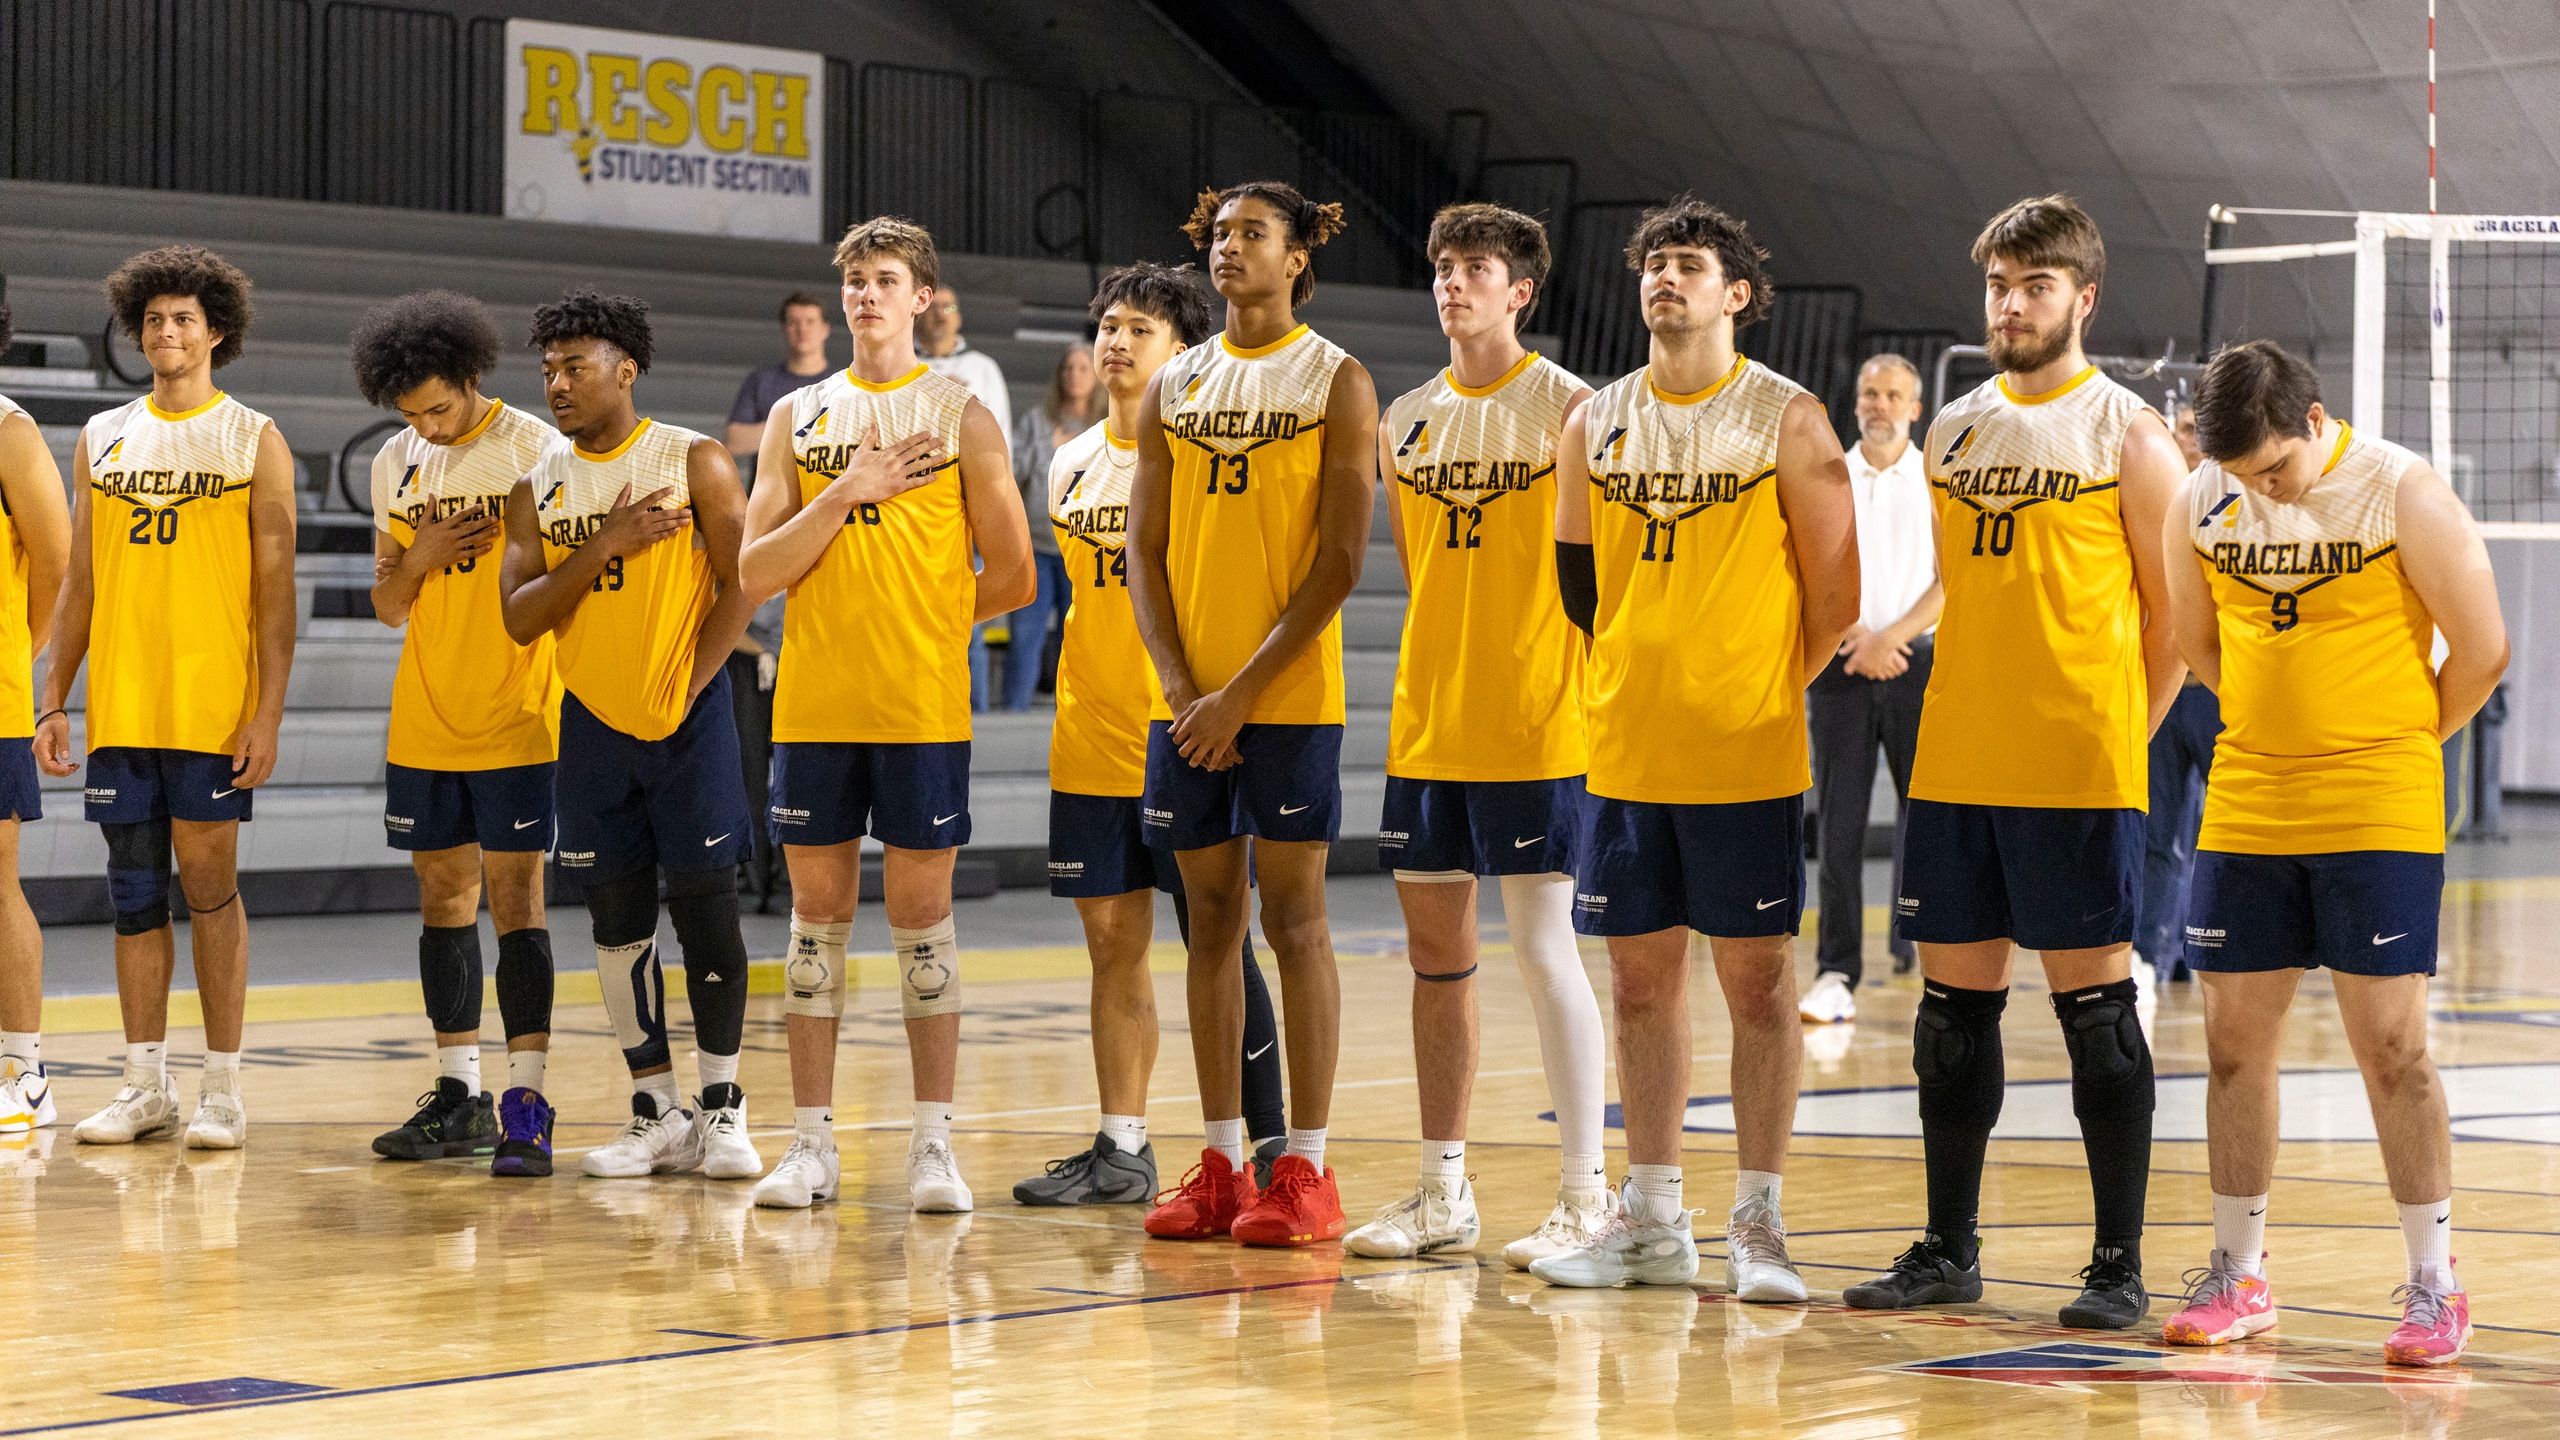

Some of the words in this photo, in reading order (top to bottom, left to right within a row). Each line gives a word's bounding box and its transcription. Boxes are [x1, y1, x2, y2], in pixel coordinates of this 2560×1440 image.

[520, 43, 810, 160] RESCH
[601, 148, 707, 188] STUDENT
[713, 159, 811, 197] SECTION
[1174, 411, 1298, 441] GRACELAND
[103, 470, 225, 499] GRACELAND
[1207, 453, 1249, 495] 13
[1413, 461, 1532, 496] GRACELAND
[1603, 472, 1739, 503] GRACELAND
[1949, 466, 2080, 503] GRACELAND
[129, 507, 179, 545] 20
[1446, 504, 1483, 549] 12
[1641, 517, 1677, 563] 11
[1971, 511, 2015, 556] 10
[1094, 547, 1127, 588] 14
[2213, 541, 2363, 575] GRACELAND
[2270, 591, 2299, 632] 9
